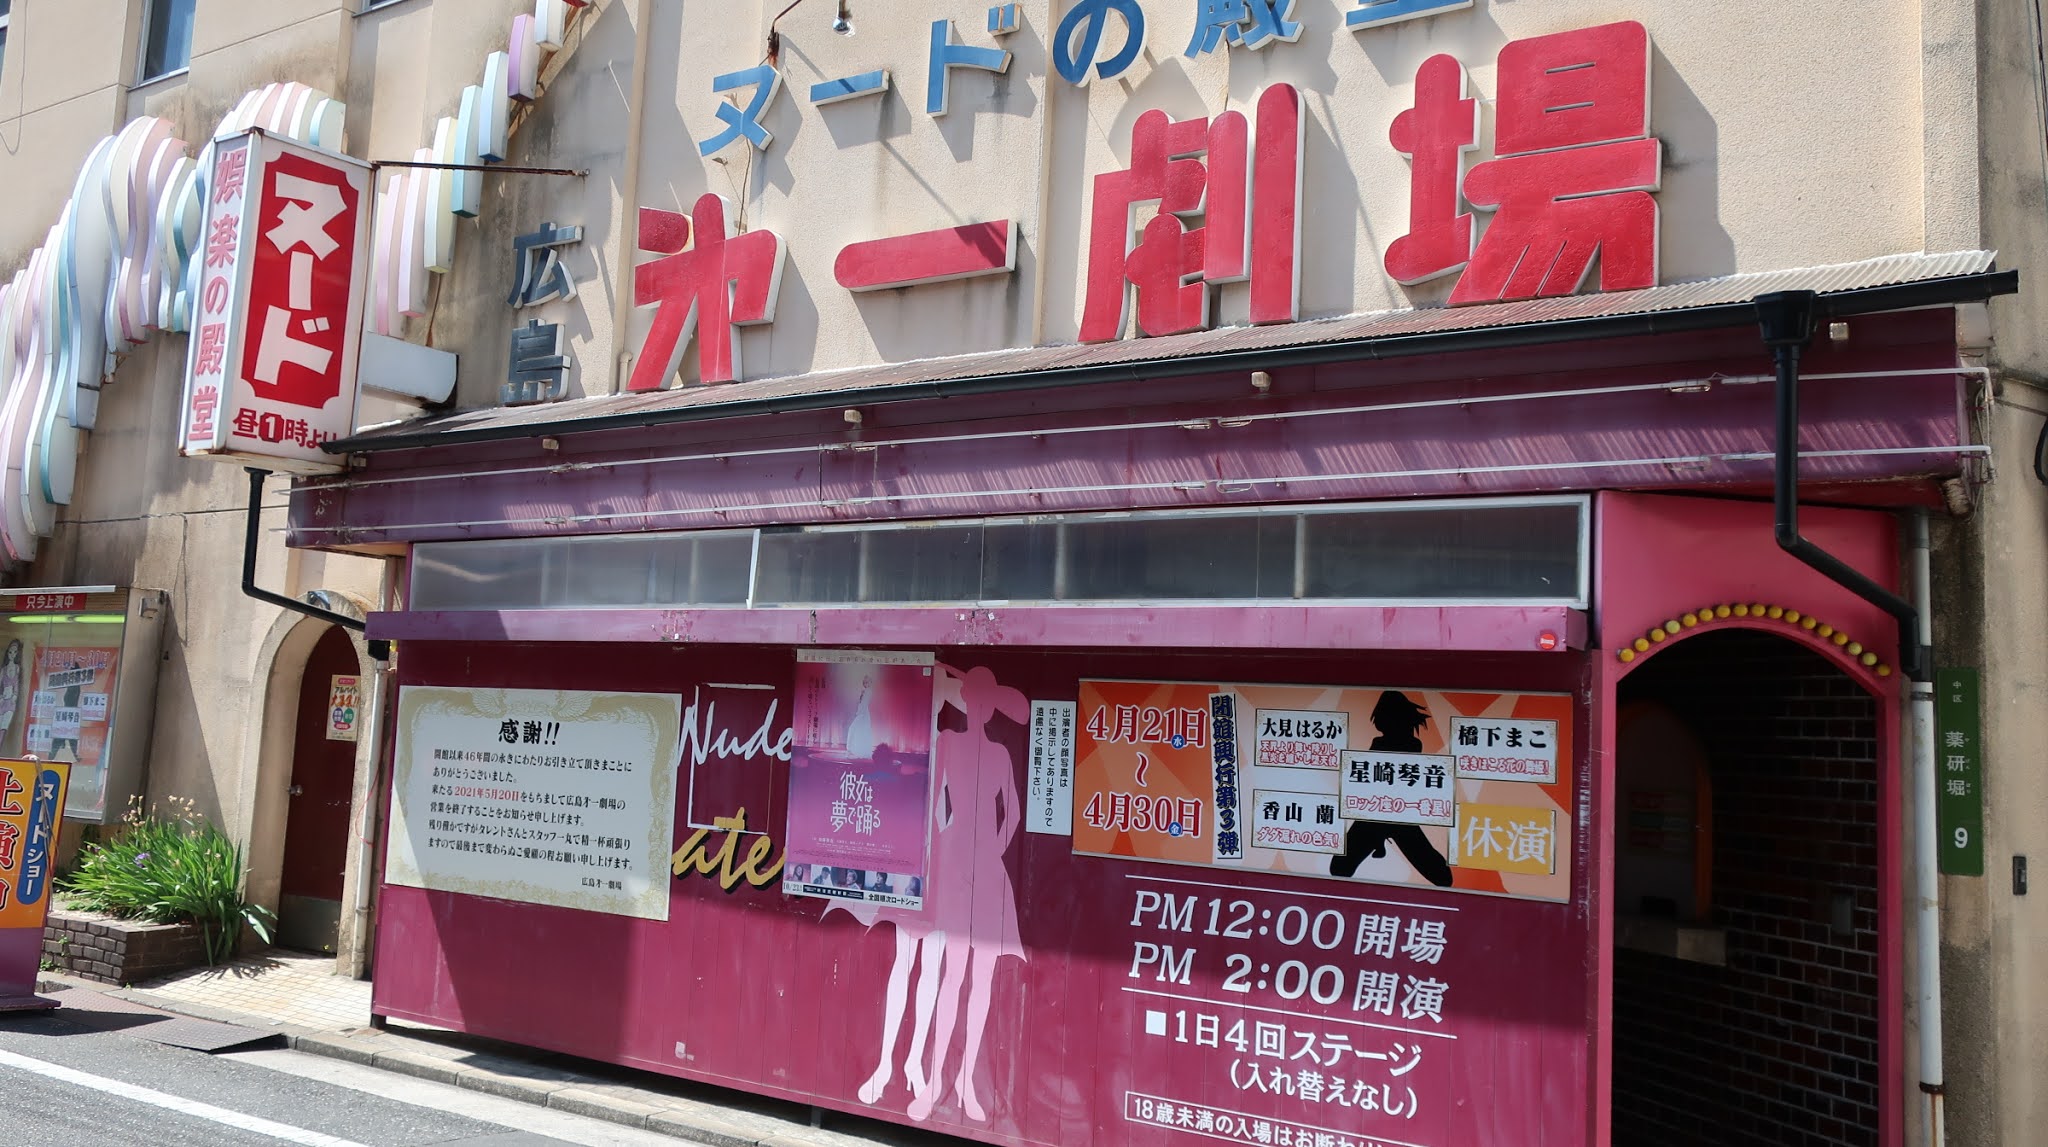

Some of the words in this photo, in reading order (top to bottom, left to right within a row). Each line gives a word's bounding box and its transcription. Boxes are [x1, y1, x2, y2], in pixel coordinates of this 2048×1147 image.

[187, 147, 248, 441] 娯楽の殿堂
[253, 171, 348, 386] ヌード
[503, 222, 584, 404] 広島
[26, 594, 75, 609] 只今上演中
[1952, 680, 1963, 703] 中区
[498, 718, 561, 746] 感謝!!
[677, 698, 793, 766] Nude
[1059, 707, 1071, 788] 出演者の顔写真は
[1086, 704, 1207, 749] 4月21日
[1171, 735, 1185, 749] 水
[1262, 717, 1342, 739] 大見はるか
[1458, 724, 1547, 748] 橋下まこ
[433, 766, 517, 783] ありがとうございました。
[1045, 707, 1058, 827] 中に掲示してありますので
[1349, 760, 1446, 789] 星崎琴音
[1945, 731, 1966, 796] 薬研堀
[839, 771, 874, 805] 彼女は
[430, 801, 584, 826] 営業を終了することをお知らせ申し上げます。
[830, 800, 881, 837] 夢で踊る
[1083, 792, 1203, 838] 4月30日
[1169, 822, 1182, 836] 金
[27, 783, 55, 896] ヌードショー
[1462, 816, 1550, 865] 休演
[1954, 827, 1968, 848] 9
[868, 893, 919, 906] 全国順次ロードショー
[1354, 913, 1448, 965] 開場
[1128, 941, 1197, 986] PM
[1222, 953, 1345, 1005] 2:00
[1352, 969, 1449, 1024] 開演
